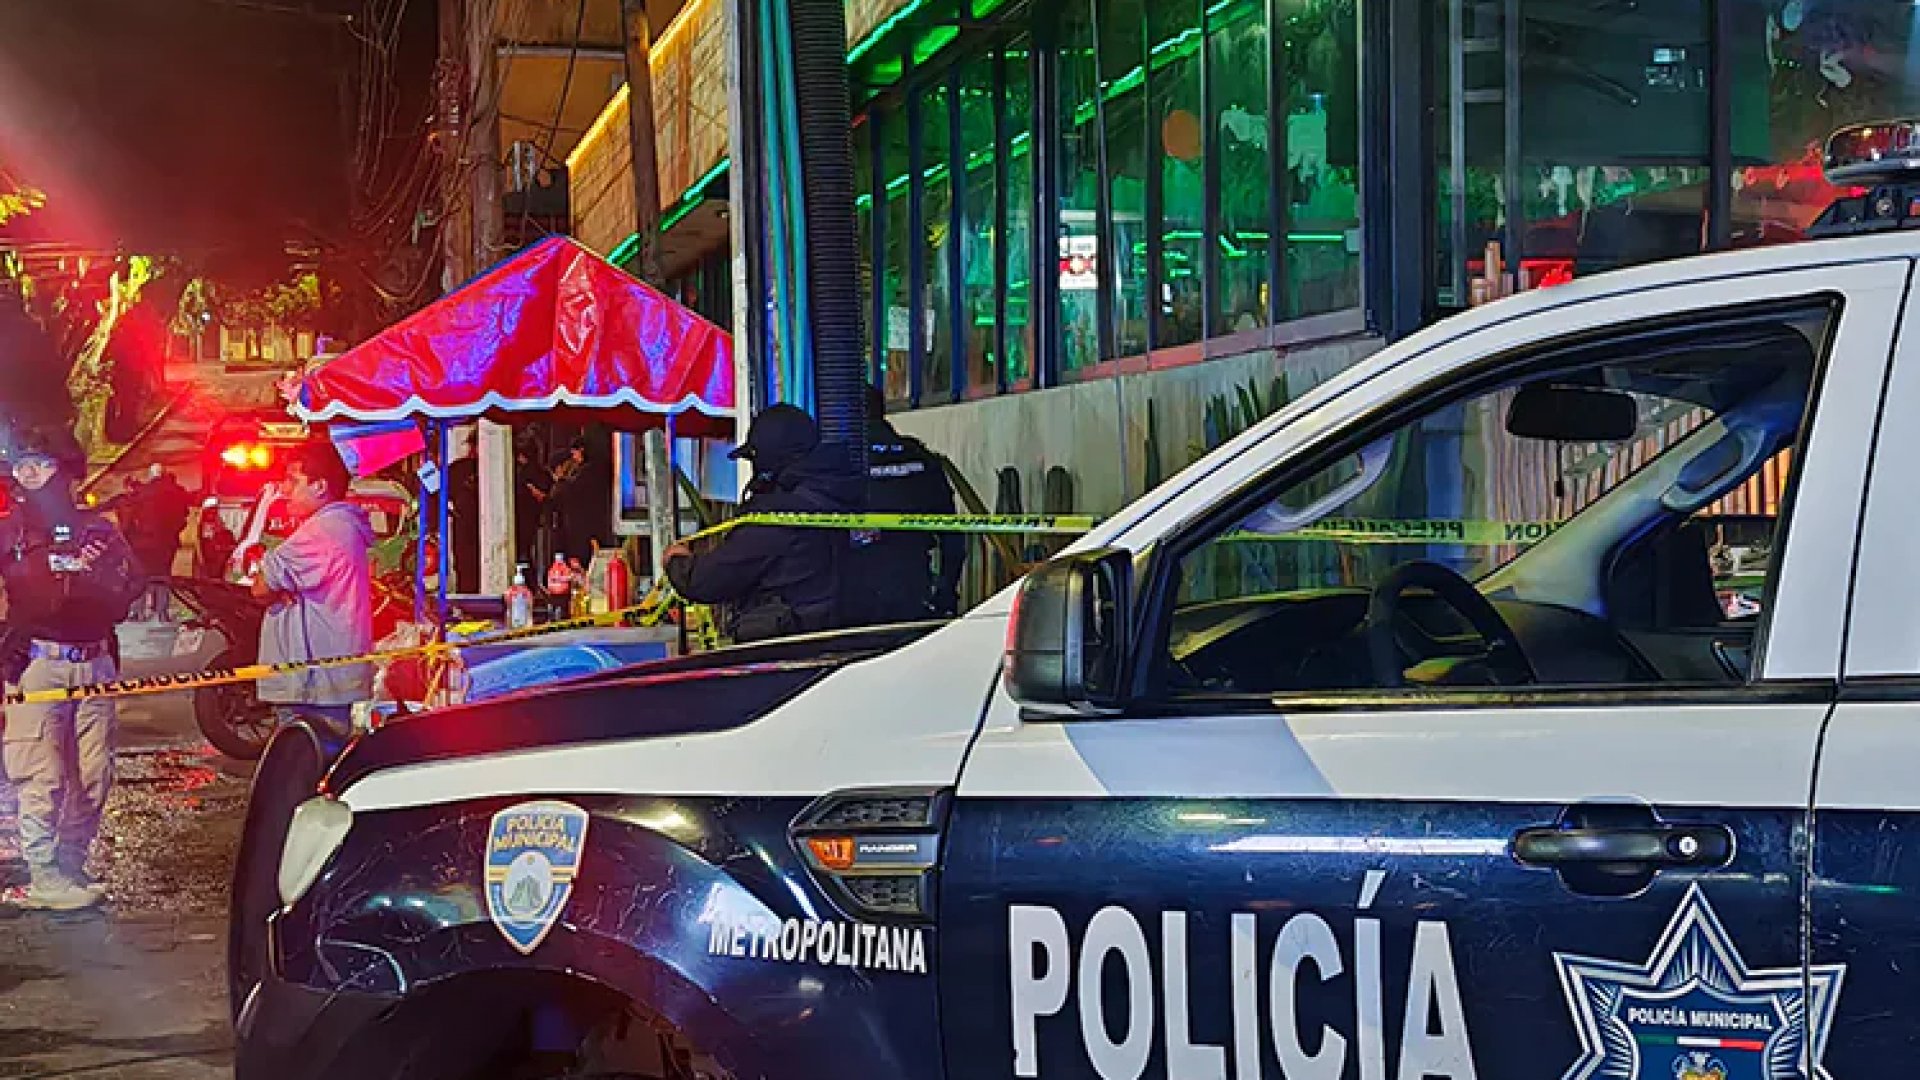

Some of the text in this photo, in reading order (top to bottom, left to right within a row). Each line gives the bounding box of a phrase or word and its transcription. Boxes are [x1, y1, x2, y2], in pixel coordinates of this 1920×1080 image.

[708, 917, 928, 974] METROPOLITANA
[1008, 869, 1478, 1080] POLICÍA
[1690, 1010, 1774, 1031] MUNICIPAL
